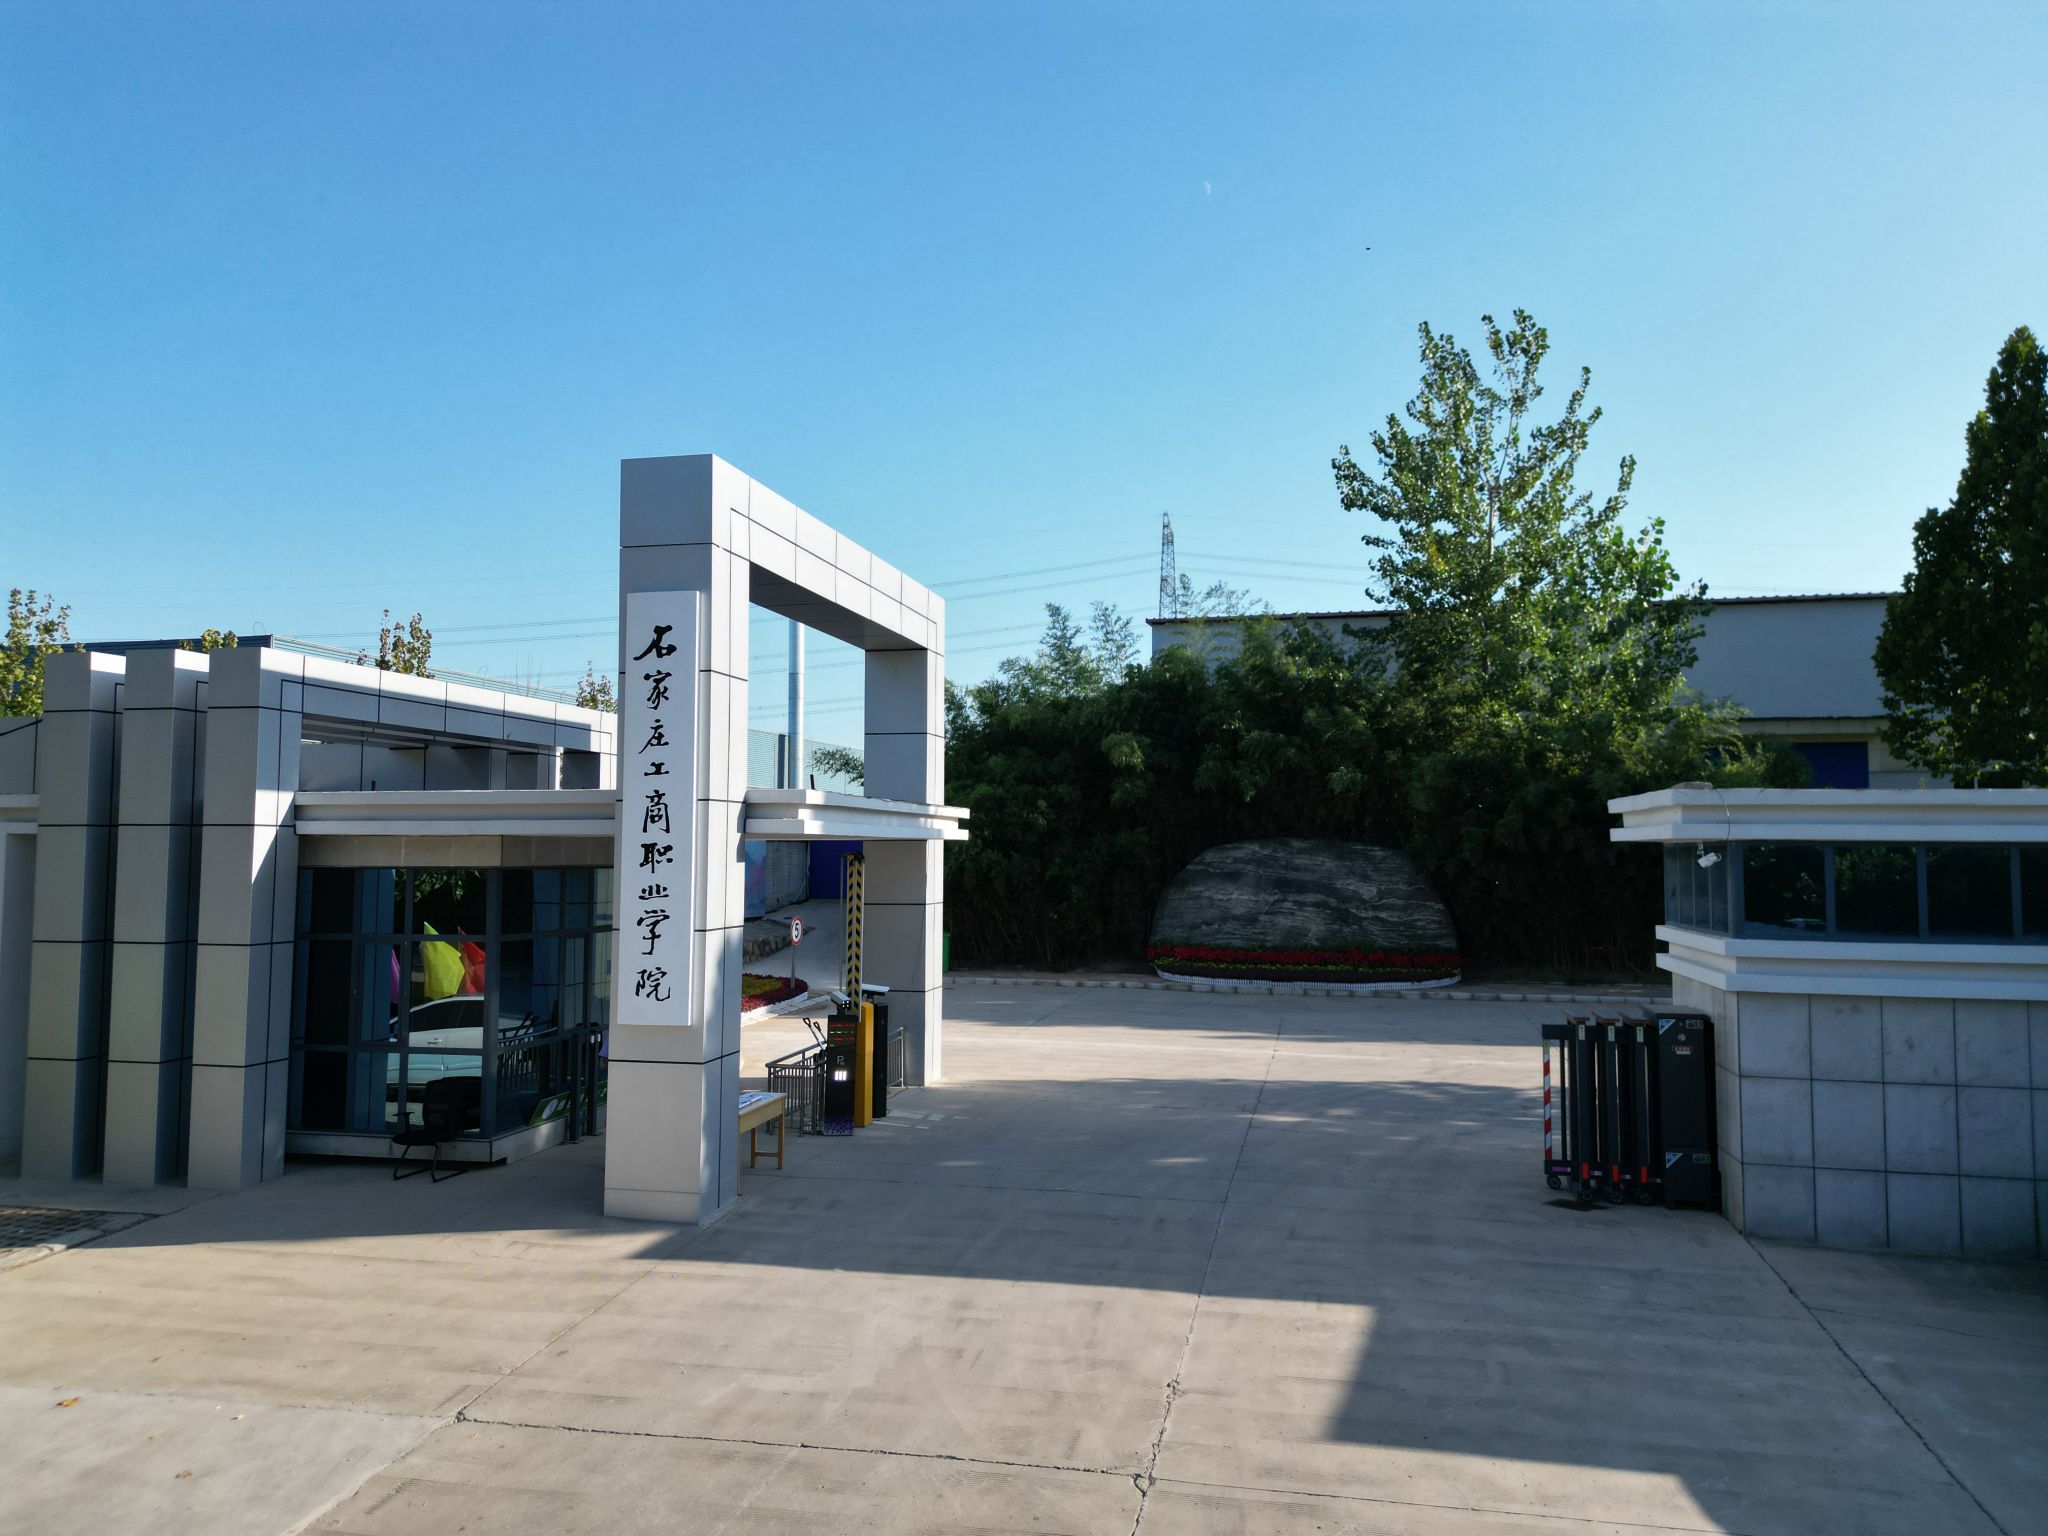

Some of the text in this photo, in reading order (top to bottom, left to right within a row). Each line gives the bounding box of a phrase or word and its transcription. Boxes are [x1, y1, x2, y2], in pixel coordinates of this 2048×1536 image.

[633, 624, 678, 1002] 石家庄工商职业学院
[793, 922, 801, 939] 5
